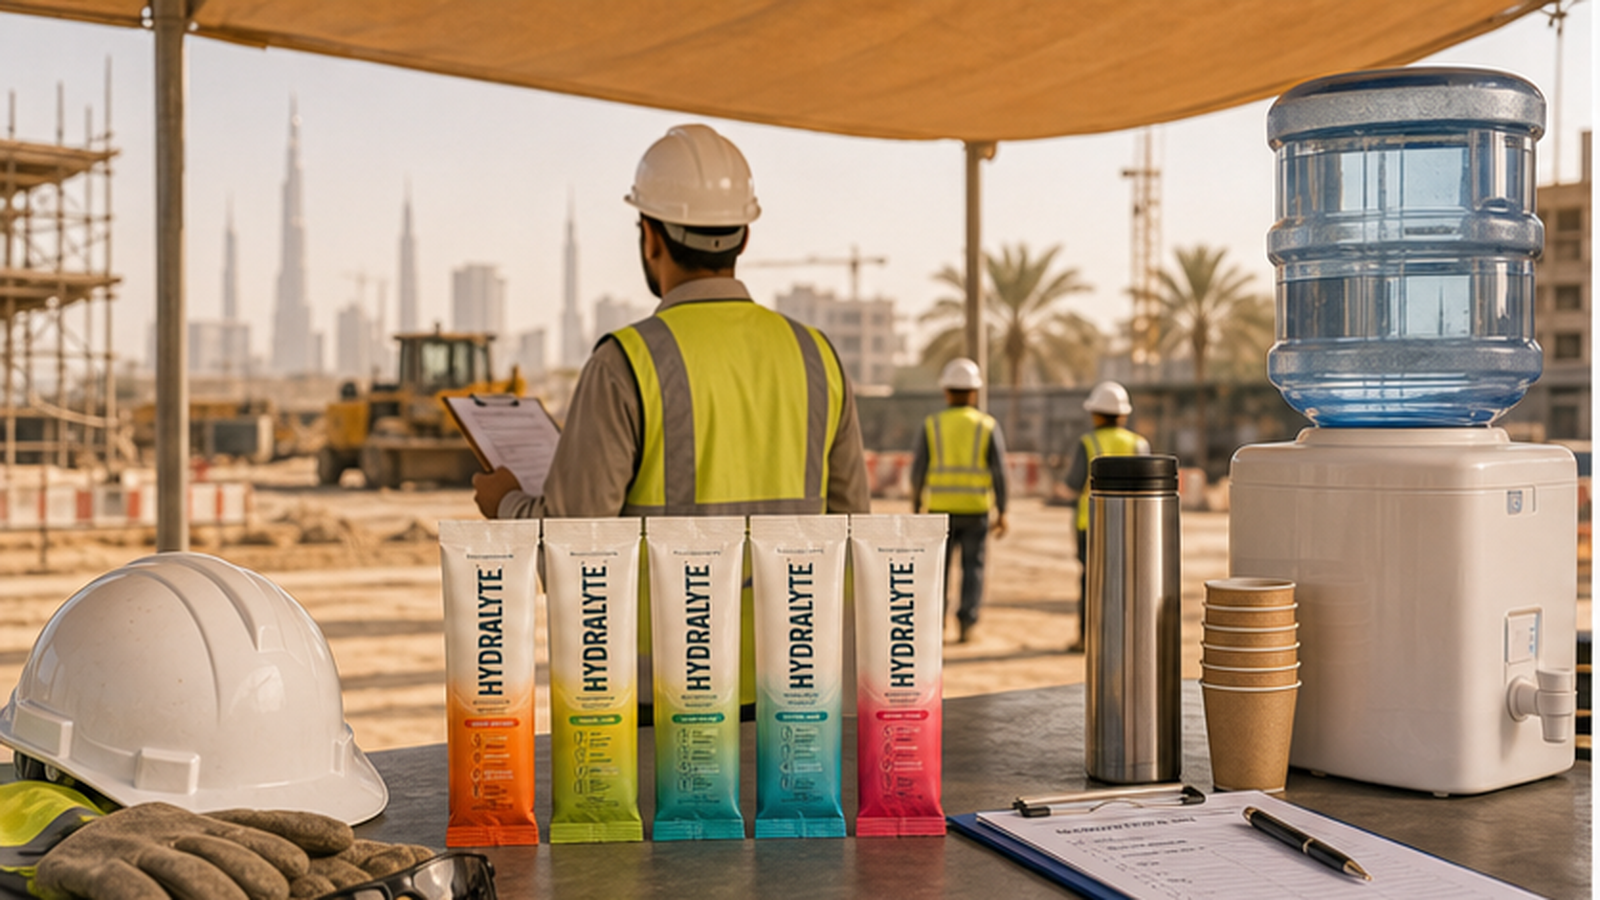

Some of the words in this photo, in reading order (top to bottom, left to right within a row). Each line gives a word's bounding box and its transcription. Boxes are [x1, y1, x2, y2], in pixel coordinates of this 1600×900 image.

[478, 568, 503, 696] HYDRALYTE
[584, 566, 608, 692] HYDRALYTE
[685, 564, 711, 690] HYDRALYTE
[789, 562, 814, 689] HYDRALYTE
[890, 562, 915, 687] HYDRALYTE
